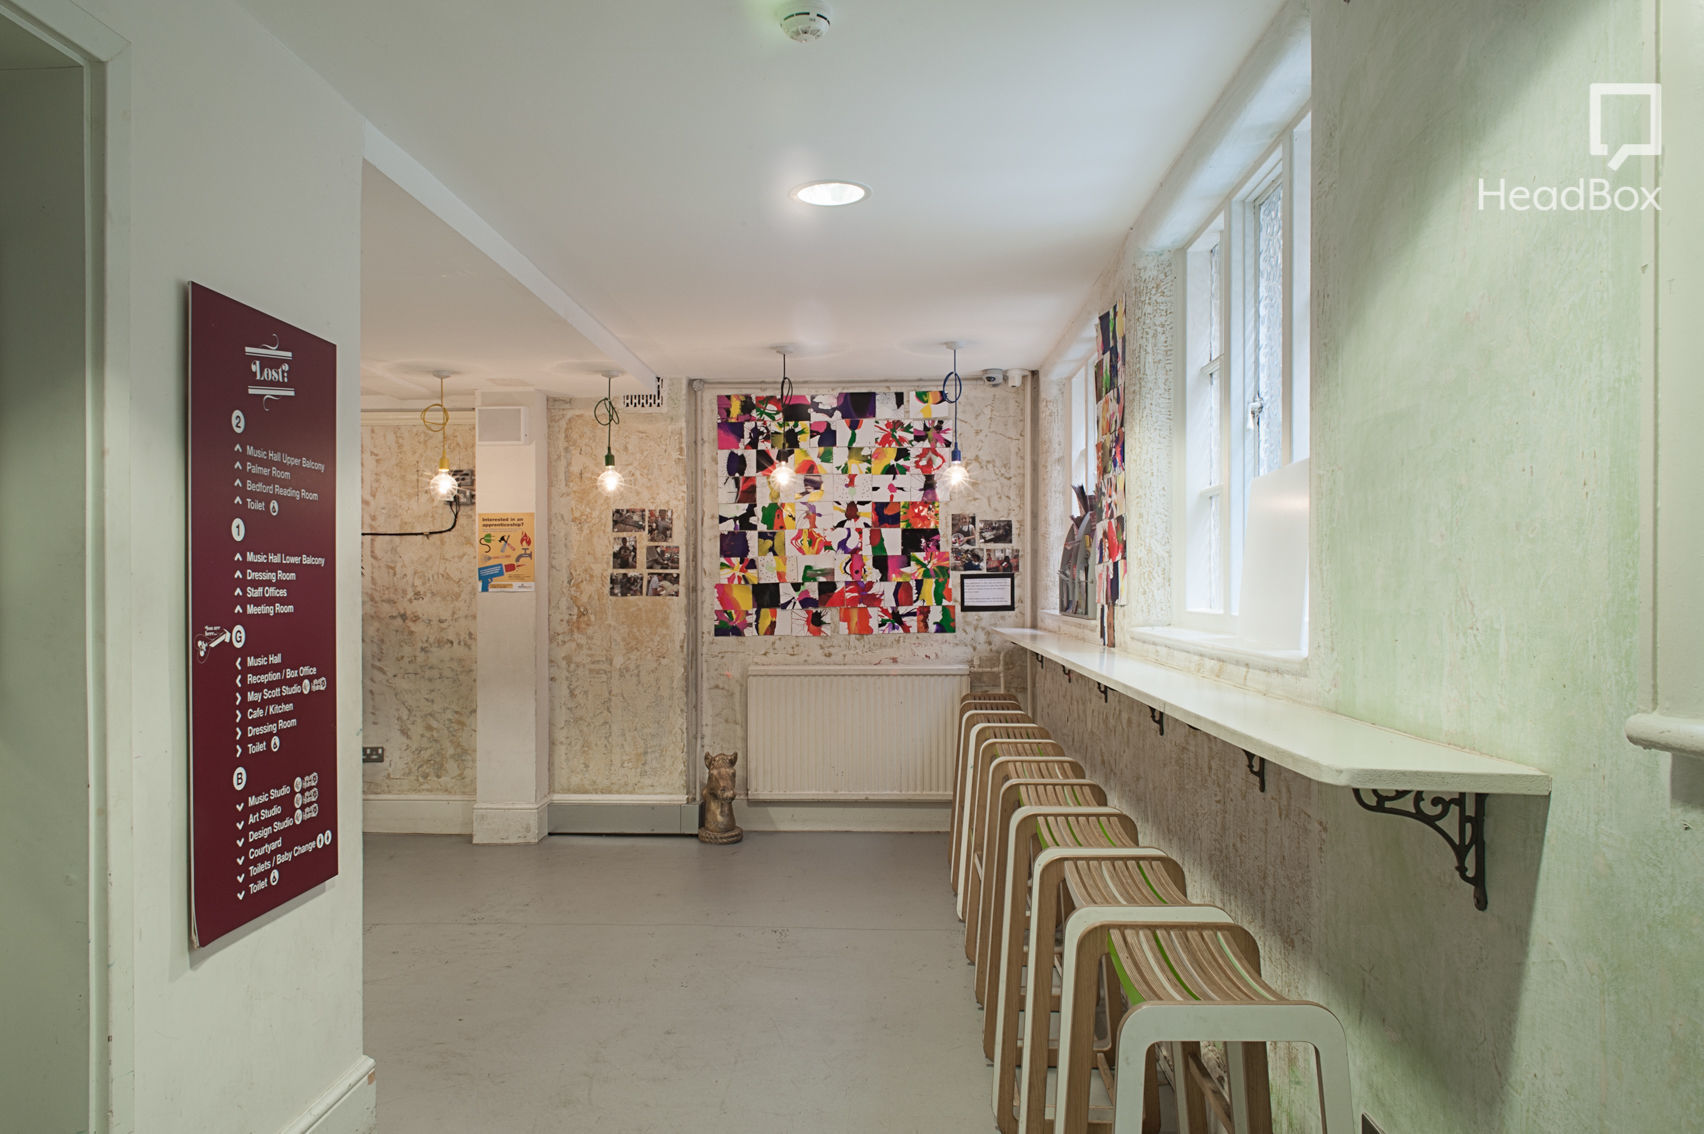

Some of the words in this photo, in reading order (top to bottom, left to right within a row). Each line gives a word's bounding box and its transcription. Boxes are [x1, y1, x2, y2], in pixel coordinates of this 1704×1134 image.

[251, 360, 289, 382] Lost?
[246, 445, 267, 458] Music
[269, 449, 281, 461] Hall
[282, 452, 301, 466] Upper
[302, 455, 324, 472] Balcony
[246, 463, 270, 476] Palmer
[272, 467, 290, 480] Room
[246, 481, 273, 494] Bedford
[275, 485, 299, 500] Reading
[301, 489, 318, 501] Room
[246, 498, 265, 511] Toilet
[247, 552, 267, 563] Music
[269, 553, 281, 563] Hall
[282, 554, 301, 564] Lower
[302, 555, 325, 566] Balcony
[247, 570, 276, 582] Dressing
[278, 571, 296, 580] Room
[247, 587, 263, 597] Staff
[264, 587, 287, 597] Offices
[247, 604, 274, 616] Meeting
[275, 604, 294, 613] Room
[247, 655, 268, 667] Music
[269, 654, 282, 664] Hall
[248, 670, 280, 686] Reception
[286, 668, 298, 678] Box
[300, 666, 316, 676] Office
[248, 690, 262, 702] May
[264, 687, 280, 698] Scott
[282, 683, 301, 697] Studio
[248, 708, 264, 719] Cafe
[269, 702, 293, 715] Kitchen
[248, 721, 277, 738] Dressing
[278, 718, 297, 730] Room
[248, 740, 266, 755] Toilet
[248, 792, 269, 807] Music
[270, 785, 290, 800] Studio
[248, 811, 259, 825] Art
[261, 804, 281, 820] Studio
[249, 825, 272, 843] Design
[274, 815, 293, 832] Studio
[249, 837, 282, 860] Courtyard
[249, 860, 271, 877] Toilets
[277, 850, 292, 865] Baby
[294, 841, 316, 857] Change
[249, 878, 268, 895] Toilet
